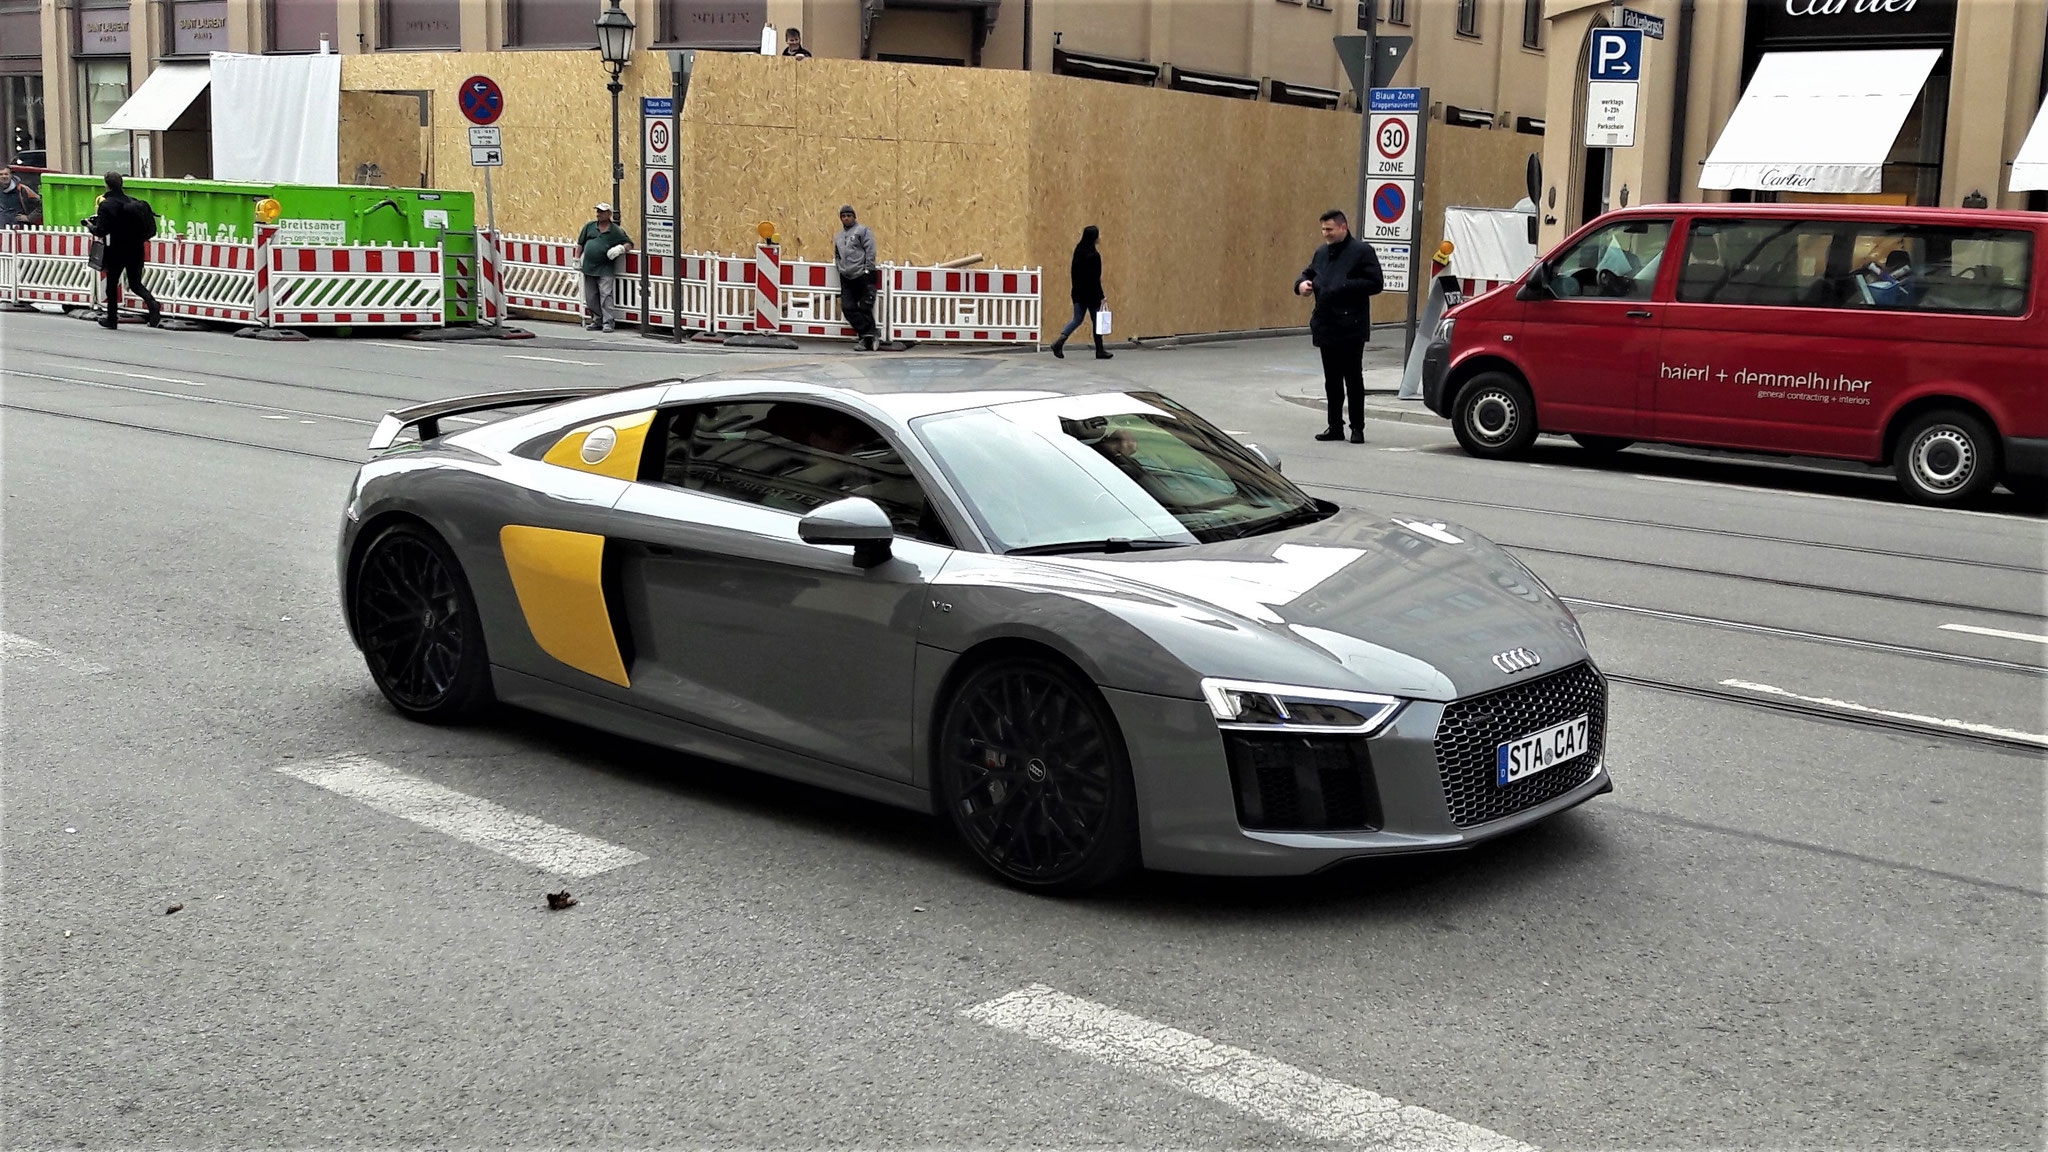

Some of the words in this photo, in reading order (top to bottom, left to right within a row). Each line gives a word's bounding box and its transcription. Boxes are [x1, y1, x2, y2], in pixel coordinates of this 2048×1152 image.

[1598, 35, 1627, 74] P
[1375, 91, 1395, 100] Blaue
[1397, 91, 1415, 100] Zone
[653, 129, 665, 144] 30
[1383, 129, 1403, 148] 30
[651, 154, 667, 164] ZONE
[1379, 161, 1404, 172] ZONE
[1760, 169, 1816, 187] Cartier
[652, 204, 668, 214] ZONE
[280, 220, 341, 231] Breitsamer
[1375, 225, 1400, 237] ZONE
[1660, 362, 1710, 382] haierl
[1734, 367, 1873, 393] demmelhuber
[1757, 390, 1786, 399] general
[1786, 391, 1830, 404] contracting
[1839, 395, 1871, 406] interiors
[1509, 737, 1543, 777] STA
